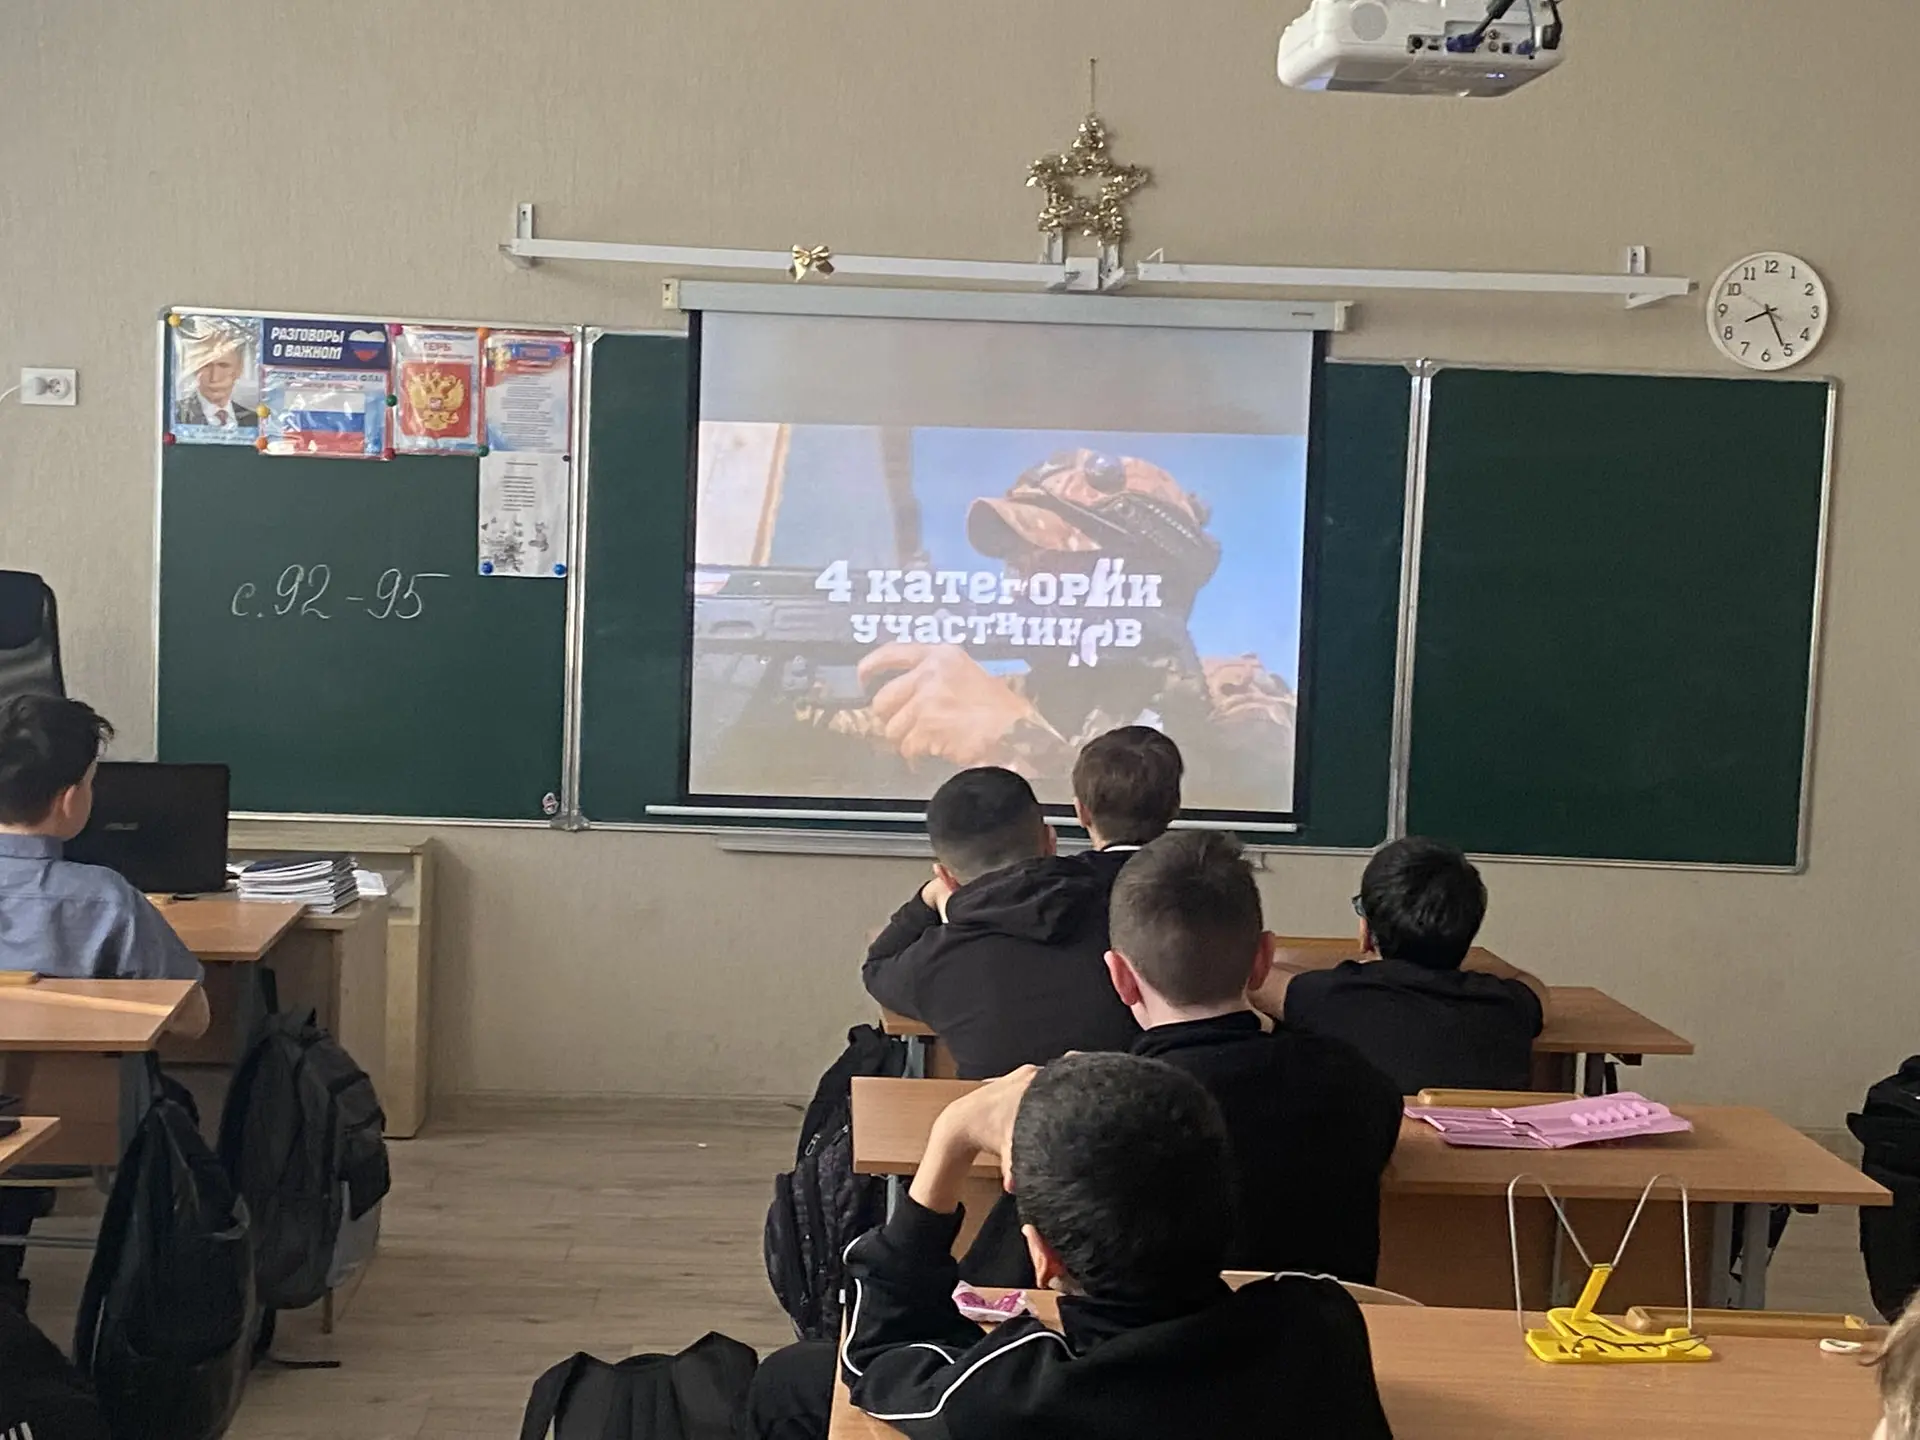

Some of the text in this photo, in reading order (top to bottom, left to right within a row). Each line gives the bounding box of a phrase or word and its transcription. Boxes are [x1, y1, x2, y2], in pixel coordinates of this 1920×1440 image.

[1743, 266, 1756, 281] 11
[1764, 260, 1779, 274] 12
[1790, 266, 1796, 279] 1
[1727, 283, 1742, 296] 10
[1804, 283, 1814, 296] 2
[1718, 303, 1728, 317] 9
[1810, 305, 1819, 319] 3
[270, 327, 345, 343] РАЗГОВОРЫ
[1724, 326, 1733, 340] 8
[1800, 328, 1809, 341] 4
[273, 345, 342, 360] О ВАЖНОМ
[1740, 342, 1750, 356] 7
[1761, 348, 1771, 362] 6
[1783, 343, 1793, 357] 5
[815, 560, 851, 602] 4
